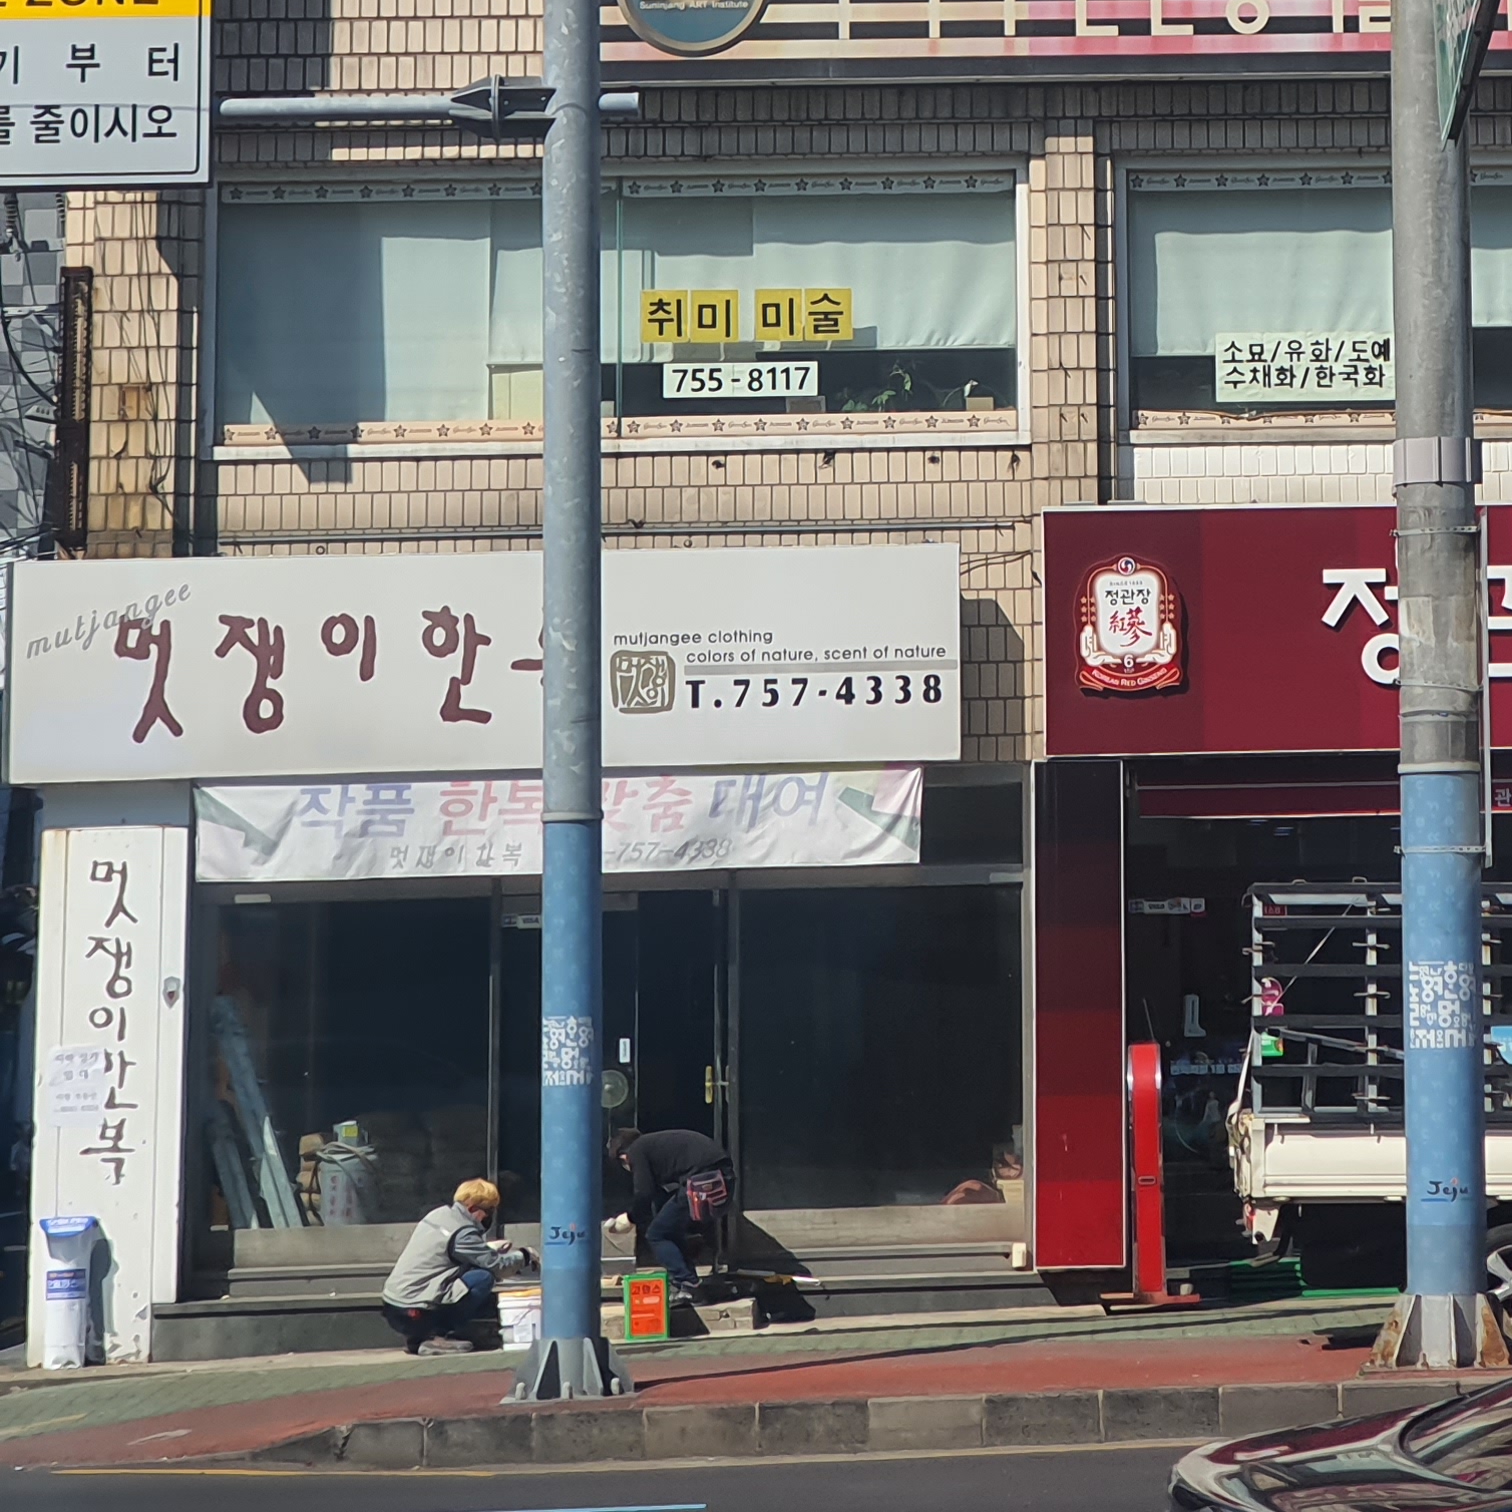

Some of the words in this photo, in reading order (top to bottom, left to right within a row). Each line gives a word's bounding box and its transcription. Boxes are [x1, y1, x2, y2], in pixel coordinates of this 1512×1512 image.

[688, 1, 708, 9] ART
[711, 0, 749, 9] Institute
[29, 103, 178, 144] 줄이시오
[647, 297, 731, 338] 취미
[761, 293, 844, 336] 미술
[1222, 337, 1391, 364] 소묘/유화/도예
[671, 366, 811, 393] 755-8117
[1223, 363, 1387, 389] 수채화/한국화
[1104, 587, 1152, 606] 정관장
[26, 583, 192, 660] mutjangee
[613, 631, 702, 648] mutjangee
[707, 628, 773, 646] clothing
[686, 649, 735, 664] colors
[739, 648, 757, 663] of
[760, 648, 819, 664] nature,
[823, 647, 869, 662] scent
[874, 646, 889, 660] of
[894, 645, 947, 660] nature
[1123, 654, 1134, 668] 6
[685, 673, 944, 710] T.757-4338
[1120, 677, 1136, 687] RED
[299, 782, 416, 838] 작품
[708, 771, 829, 829] 대여
[1426, 1179, 1470, 1202] Jeju
